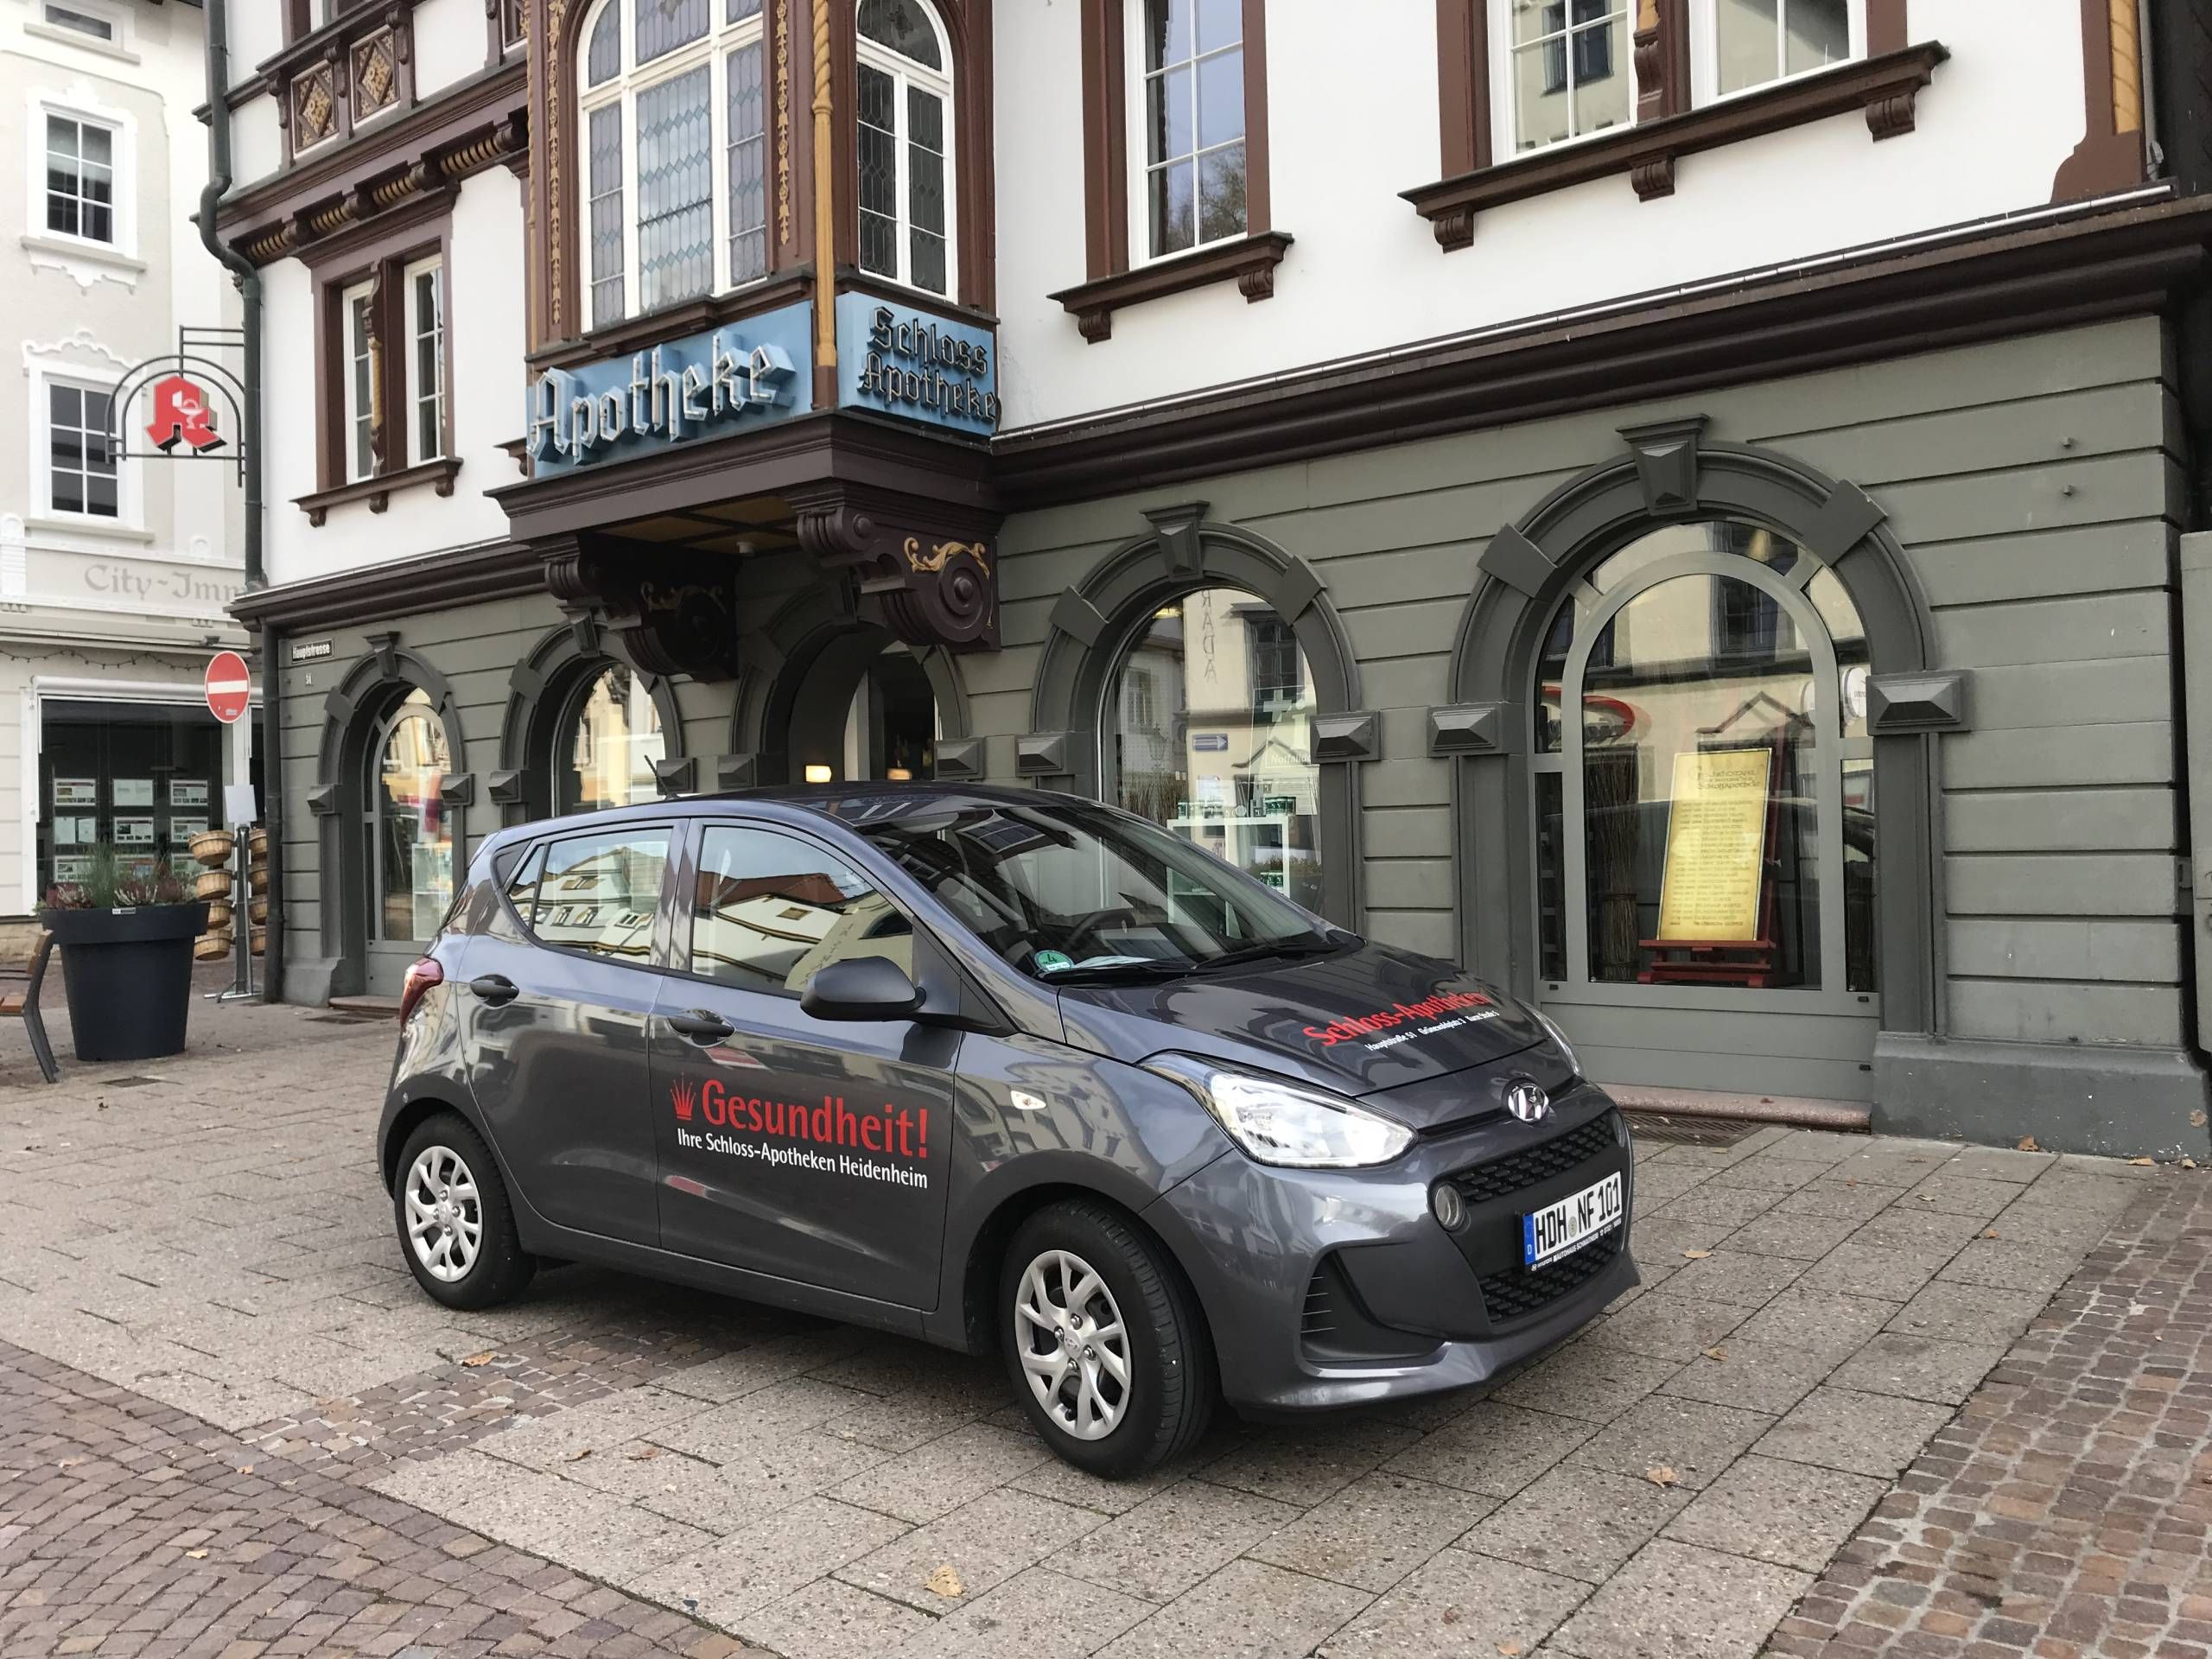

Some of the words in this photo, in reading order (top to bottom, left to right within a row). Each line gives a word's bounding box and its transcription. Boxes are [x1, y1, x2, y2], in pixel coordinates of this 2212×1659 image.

[868, 306, 988, 375] Schloss
[526, 329, 793, 466] Apotheke
[858, 350, 996, 422] Apotheke
[1303, 992, 1493, 1046] Schloss-Apotheken
[702, 1079, 928, 1158] Gesundheit!
[677, 1128, 702, 1149] Ihre
[706, 1133, 836, 1172] Schloss-Apotheken
[839, 1155, 928, 1189] Heidenheim
[1535, 1205, 1567, 1254] HDH
[1577, 1191, 1594, 1234] NF
[1599, 1178, 1620, 1223] 101
